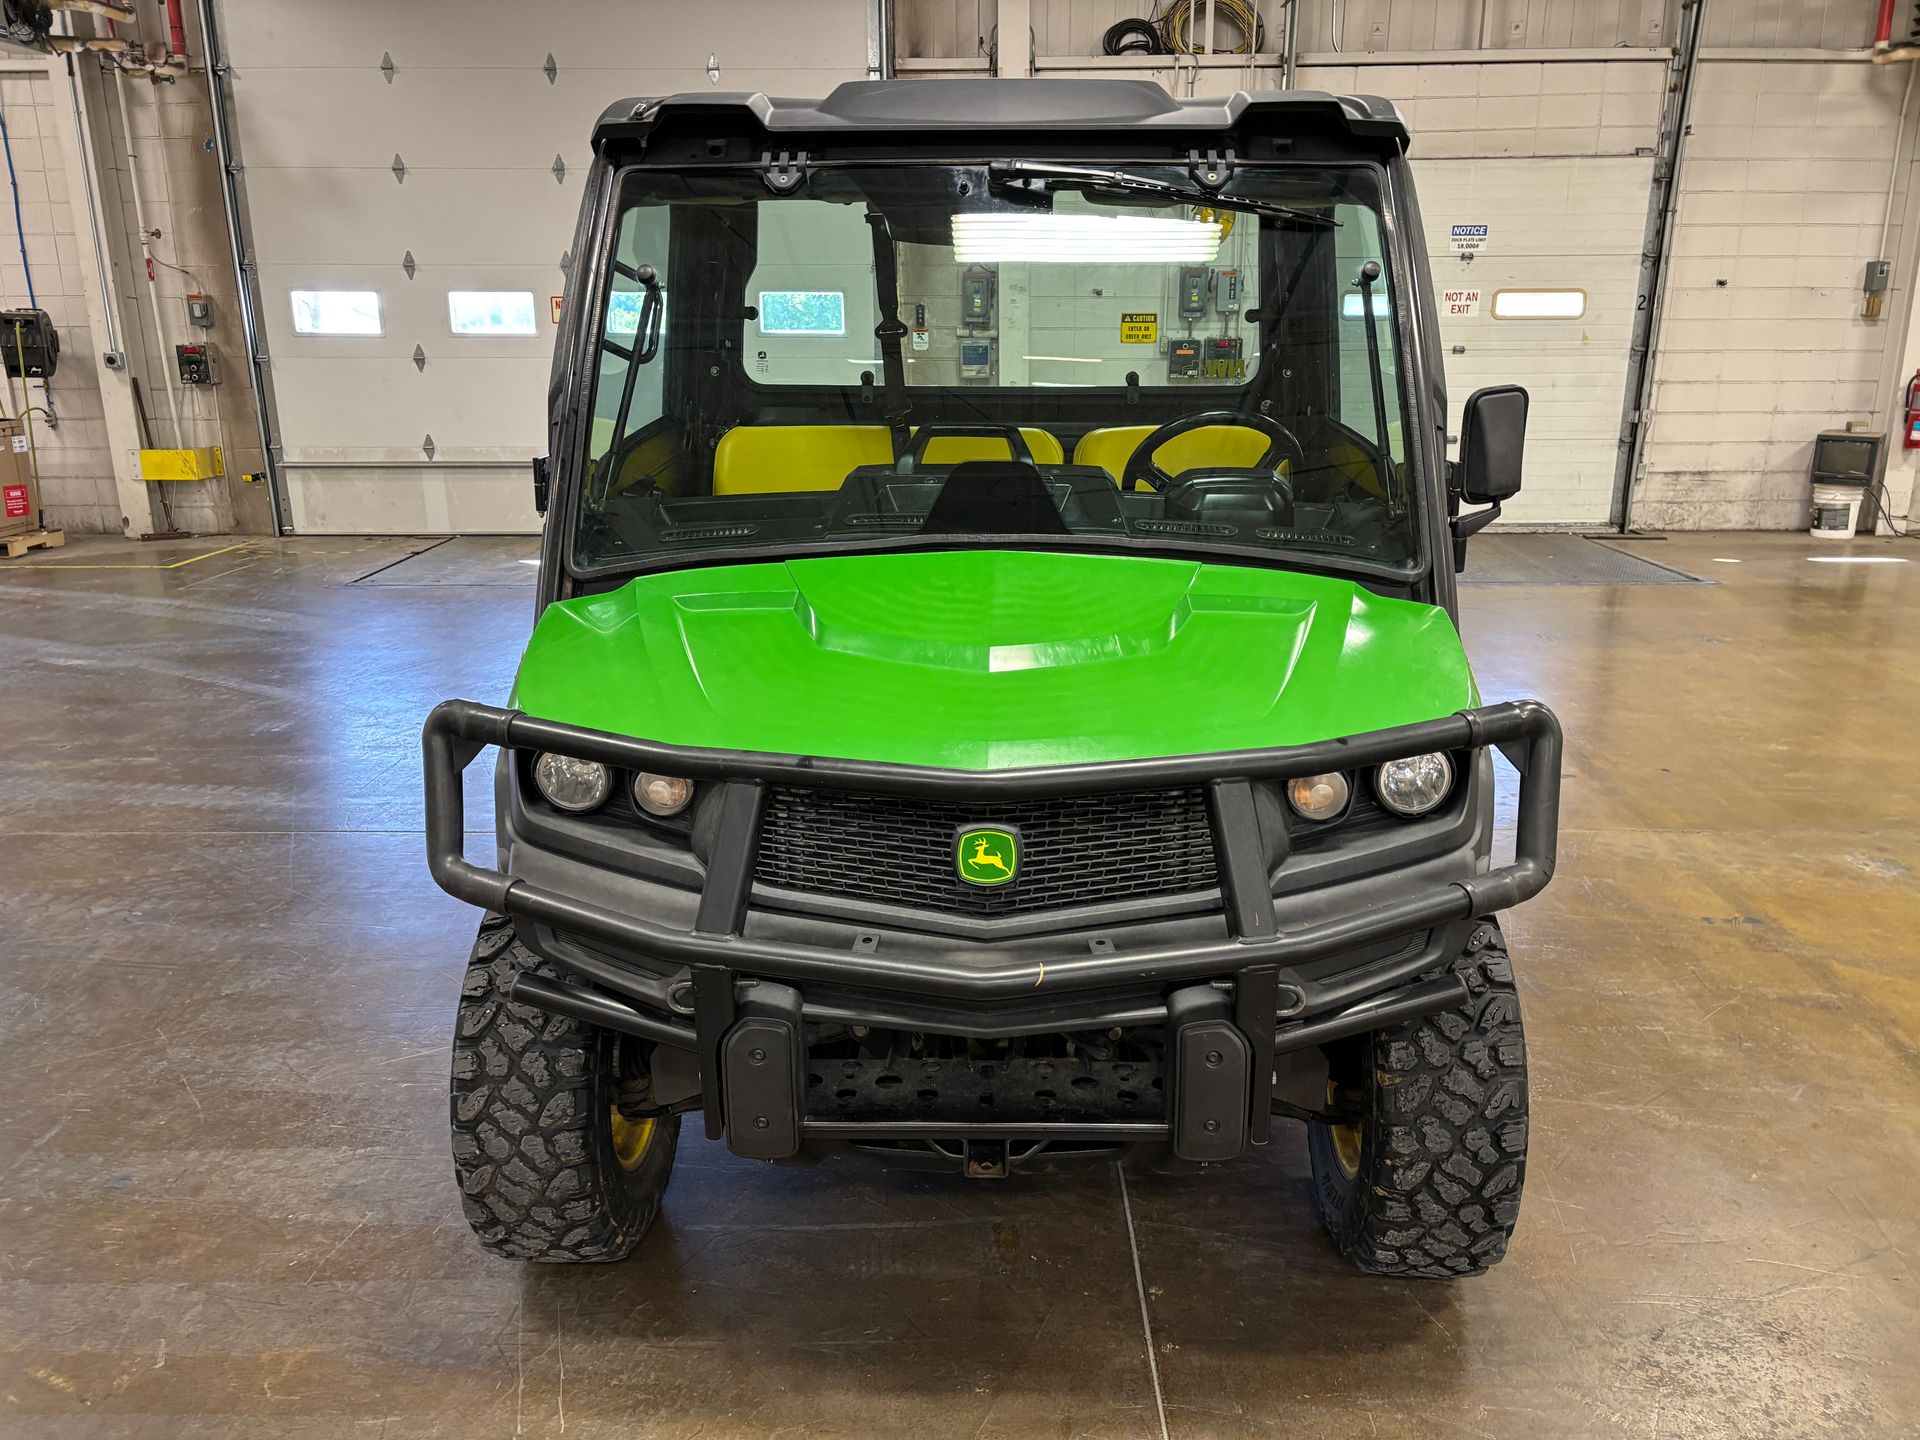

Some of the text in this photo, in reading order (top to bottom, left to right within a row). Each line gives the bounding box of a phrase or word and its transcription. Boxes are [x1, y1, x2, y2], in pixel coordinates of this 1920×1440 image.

[1453, 226, 1487, 235] NOTICE
[1445, 292, 1479, 302] NOT AN
[1638, 295, 1647, 311] 2
[1450, 304, 1471, 314] EXIT
